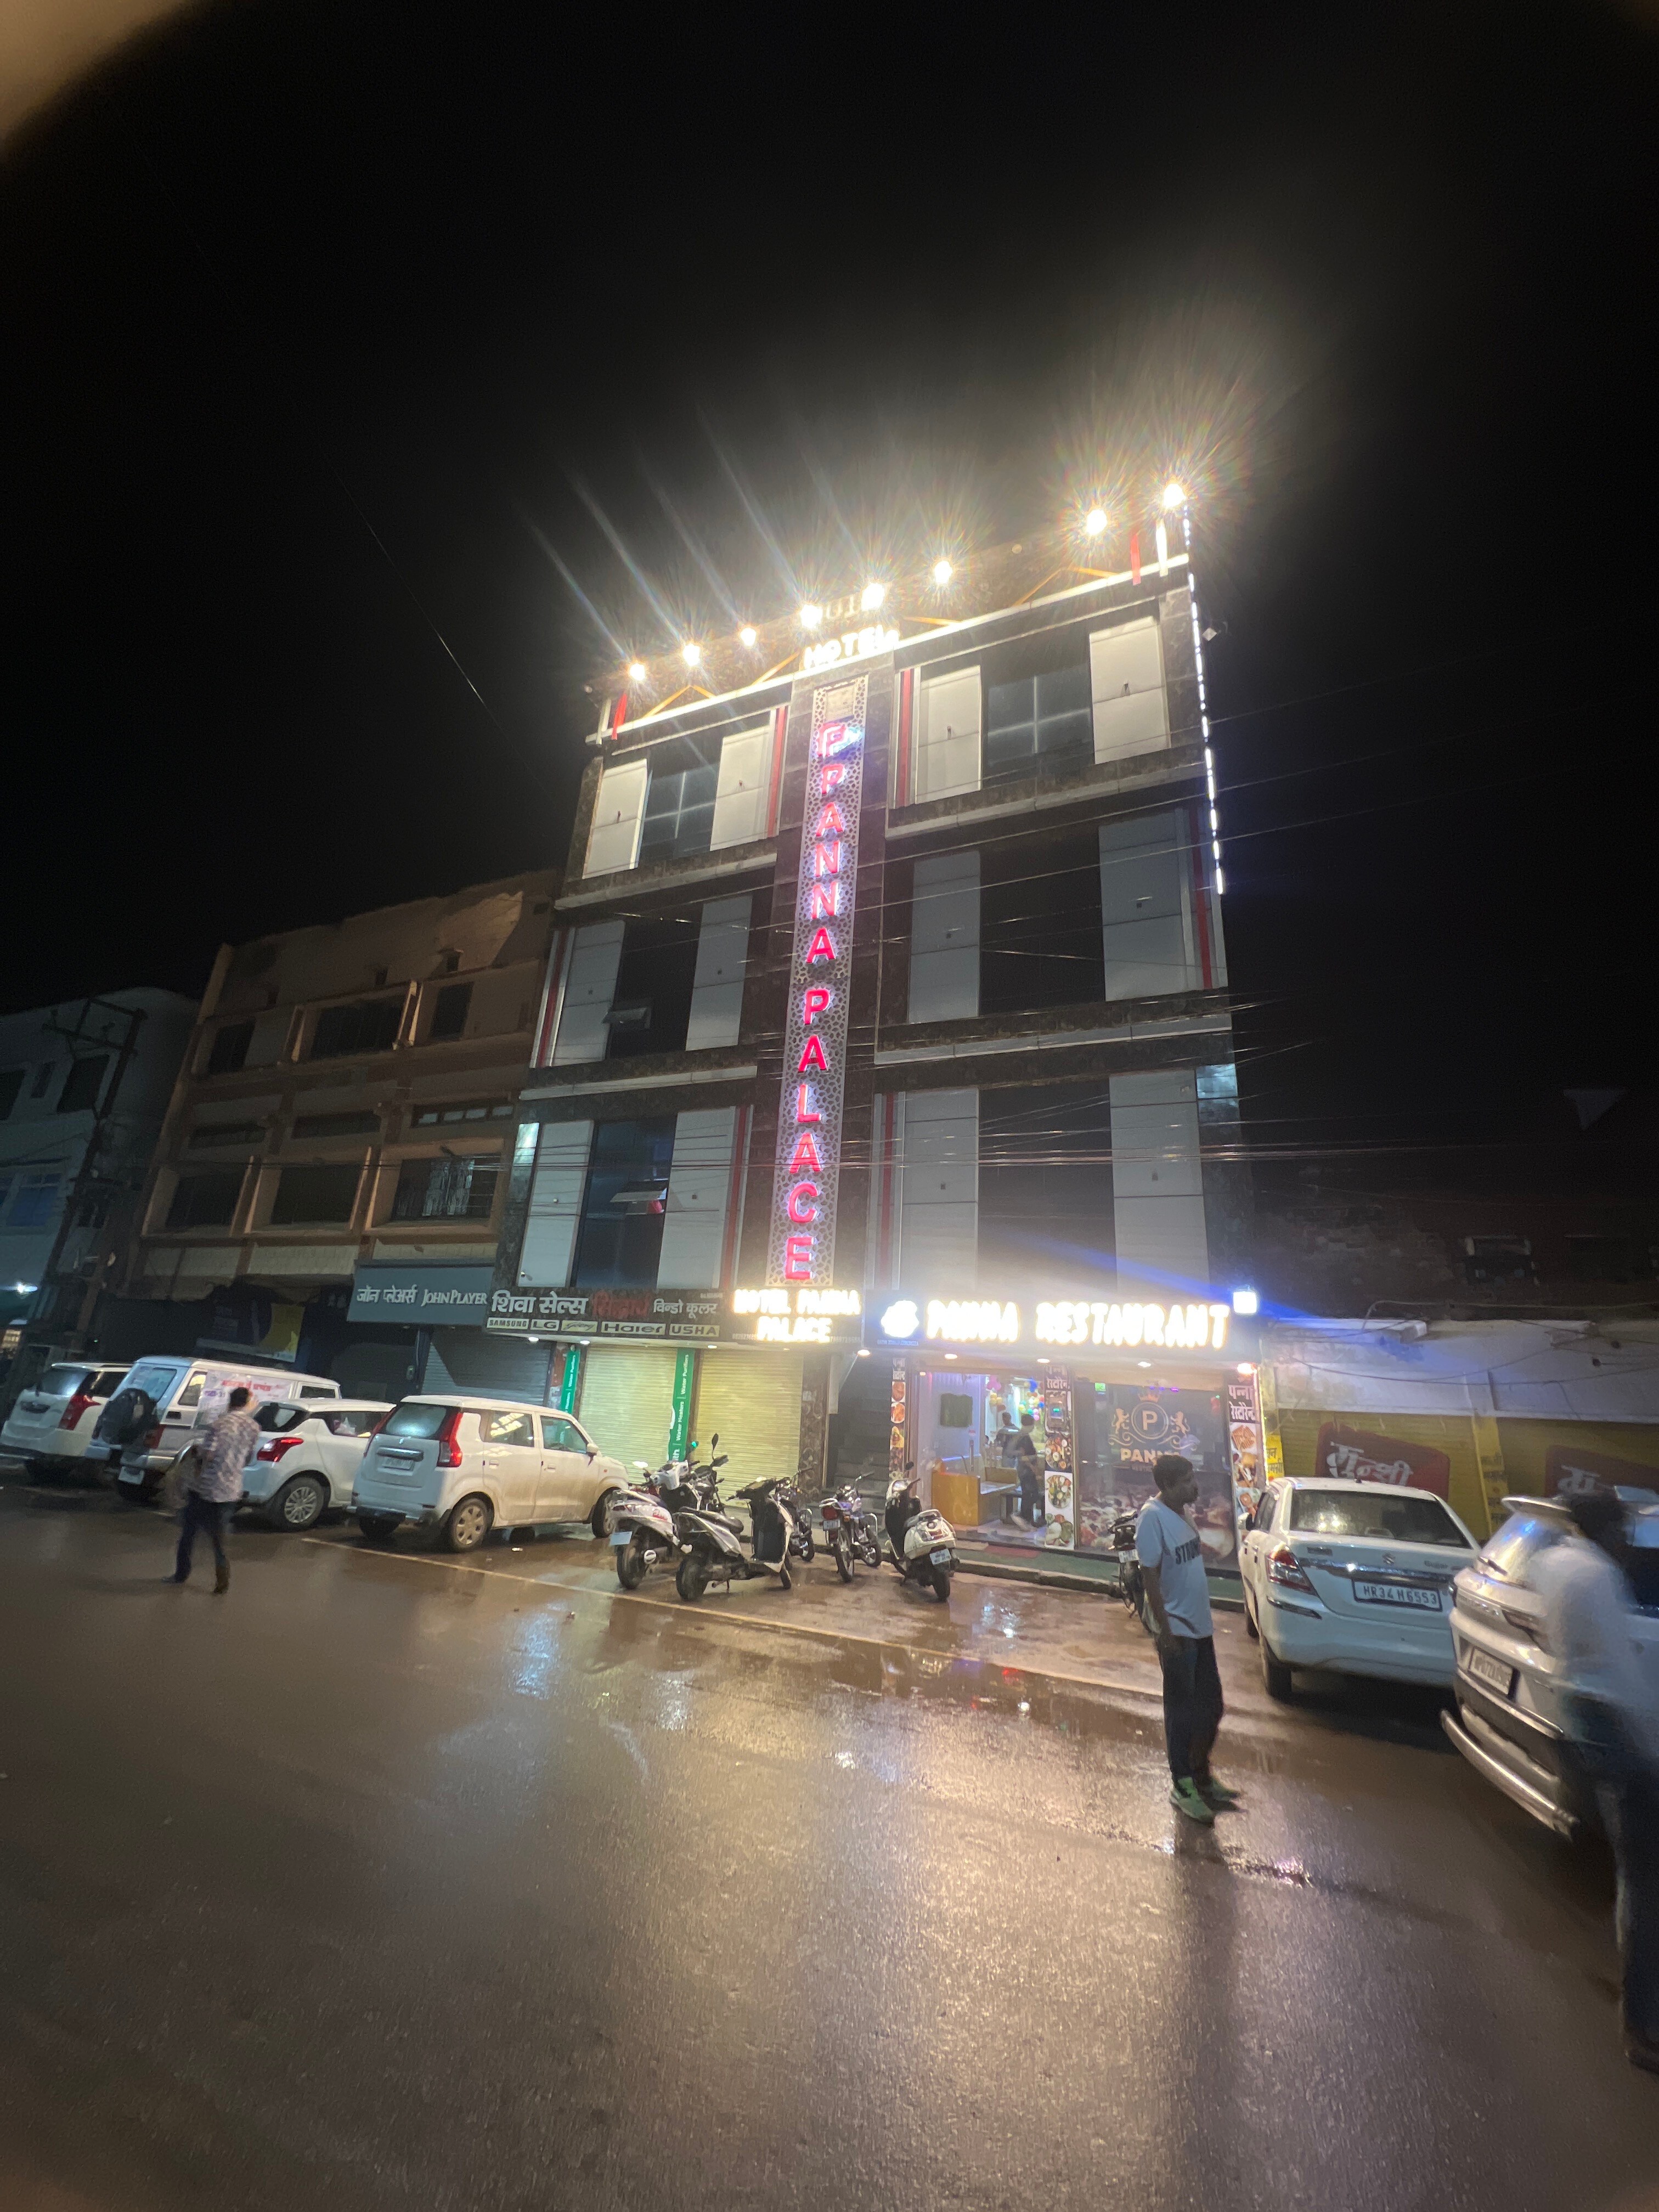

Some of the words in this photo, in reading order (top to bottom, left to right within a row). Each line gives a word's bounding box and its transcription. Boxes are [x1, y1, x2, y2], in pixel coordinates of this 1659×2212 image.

[805, 763, 846, 963] PANNA
[785, 988, 830, 1280] PALACE
[492, 1290, 537, 1313] शिवा
[539, 1291, 589, 1314] सेल्स
[653, 1299, 684, 1314] विन्डो
[686, 1303, 718, 1318] कूलर
[604, 1323, 663, 1333] Haier
[672, 1326, 716, 1335] USHA
[1036, 1302, 1231, 1349] RESTAURANT
[1142, 1410, 1158, 1431] P
[1120, 1448, 1180, 1466] PAN
